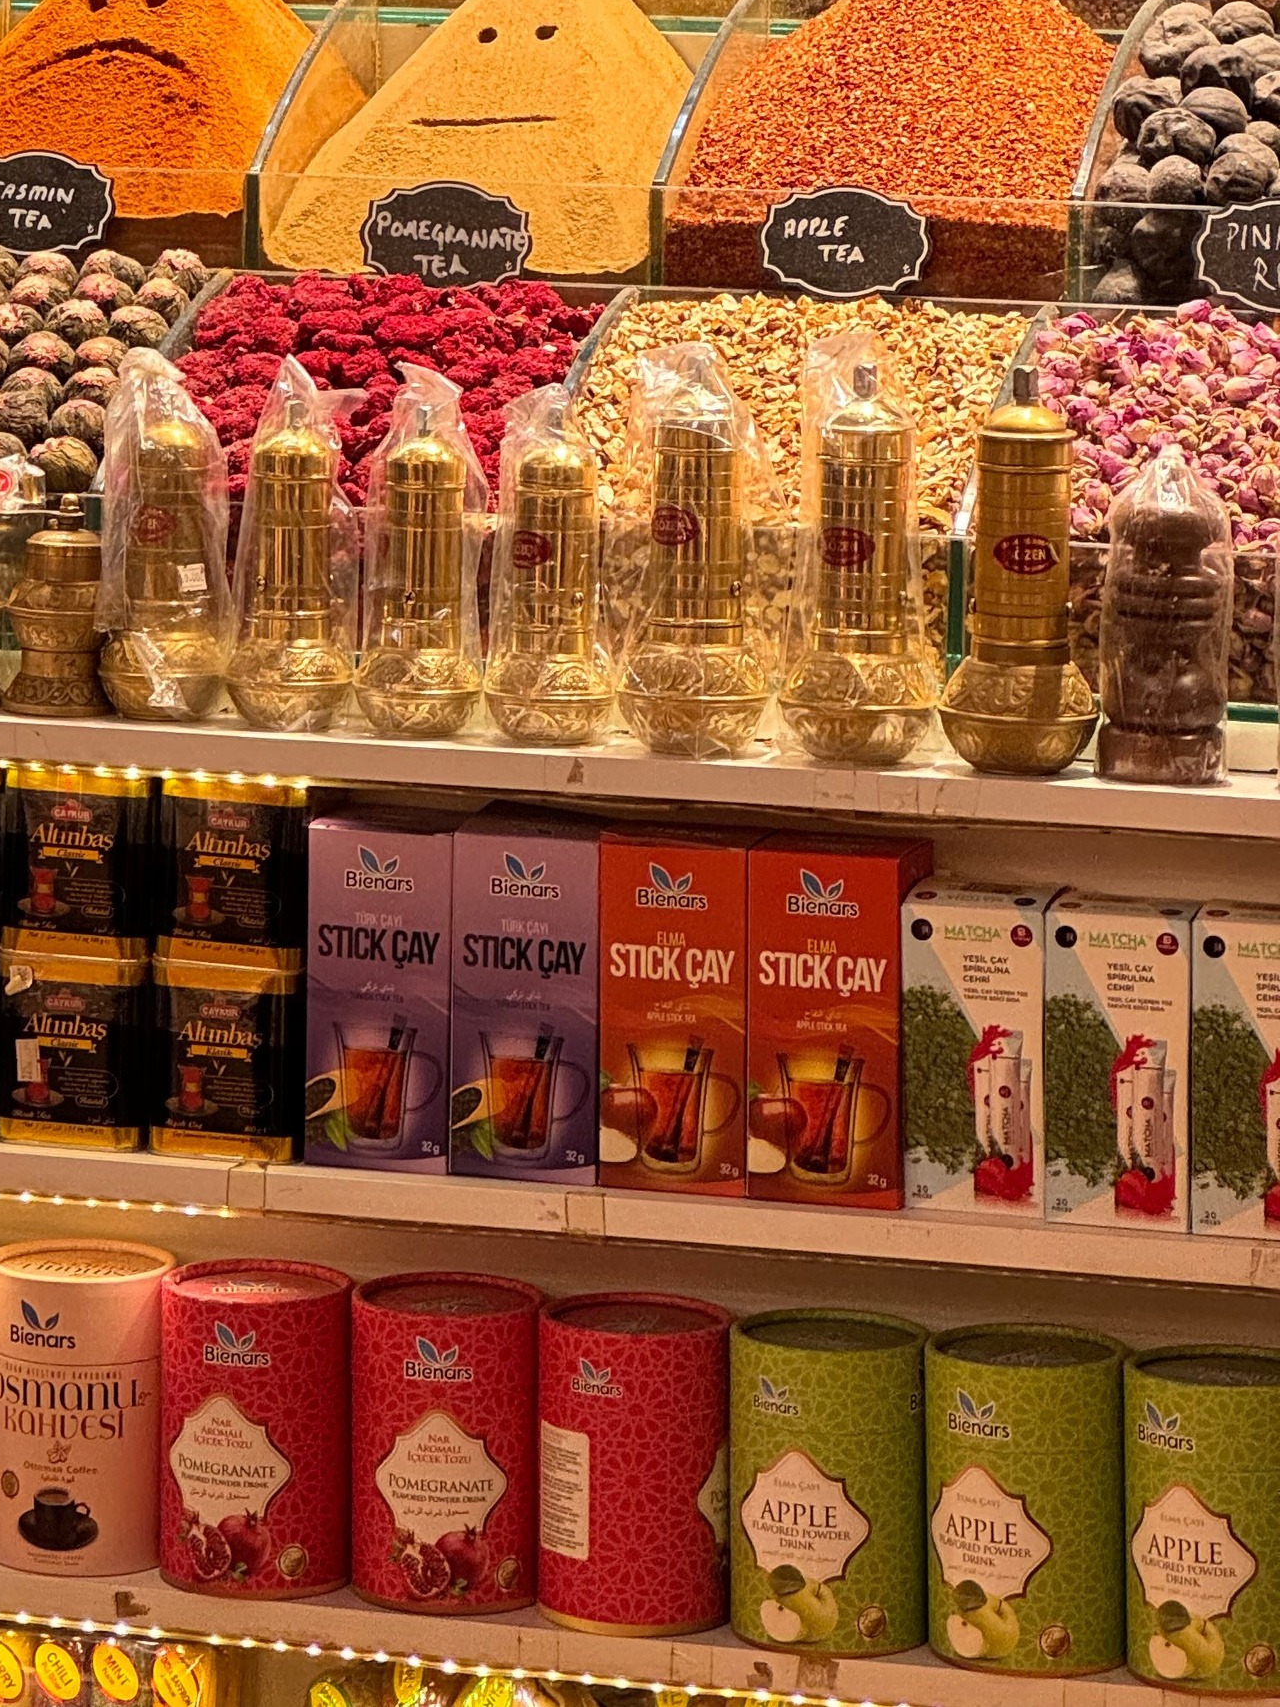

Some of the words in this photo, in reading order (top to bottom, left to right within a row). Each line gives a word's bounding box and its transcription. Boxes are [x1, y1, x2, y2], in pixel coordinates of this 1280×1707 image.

[8, 208, 52, 230] TEA
[783, 214, 850, 239] APPLE
[376, 210, 528, 252] POMEGRANATE
[413, 253, 469, 278] TEA
[818, 243, 865, 265] TEA
[345, 871, 413, 892] Bienars
[490, 877, 560, 899] Bienars
[637, 889, 707, 910] Bienars
[787, 895, 859, 917] Bienars
[318, 924, 387, 961] STICK
[392, 929, 440, 969] ÇAY
[657, 931, 686, 947] ELMA
[807, 938, 837, 955] ELMA
[463, 934, 533, 971] STICK
[538, 939, 586, 979] ÇAY
[610, 943, 682, 981] STICK
[686, 948, 735, 988] ÇAY
[759, 951, 831, 990] STICK
[836, 956, 887, 998] ÇAY
[9, 1324, 76, 1351] Bienars
[203, 1345, 270, 1368] Bienars
[404, 1360, 473, 1382] Bienars
[572, 1376, 623, 1396] Bienars
[753, 1394, 800, 1416] Bienars
[201, 1425, 243, 1439] AROMALI
[211, 1416, 232, 1428] NAR
[948, 1413, 1010, 1440] Bienars
[428, 1433, 451, 1445] NAR
[1137, 1424, 1194, 1451] Bienars
[417, 1443, 462, 1456] AROMALI
[178, 1454, 277, 1481] POMEGRANATE
[388, 1472, 494, 1495] POMEGRANATE
[760, 1499, 839, 1528] APPLE
[804, 1527, 852, 1542] POWDER
[946, 1514, 1019, 1546] APPLE
[779, 1538, 816, 1553] DRINK
[1148, 1534, 1223, 1565] APPLE
[47, 1652, 73, 1687] CHILI
[105, 1654, 131, 1686] MINT
